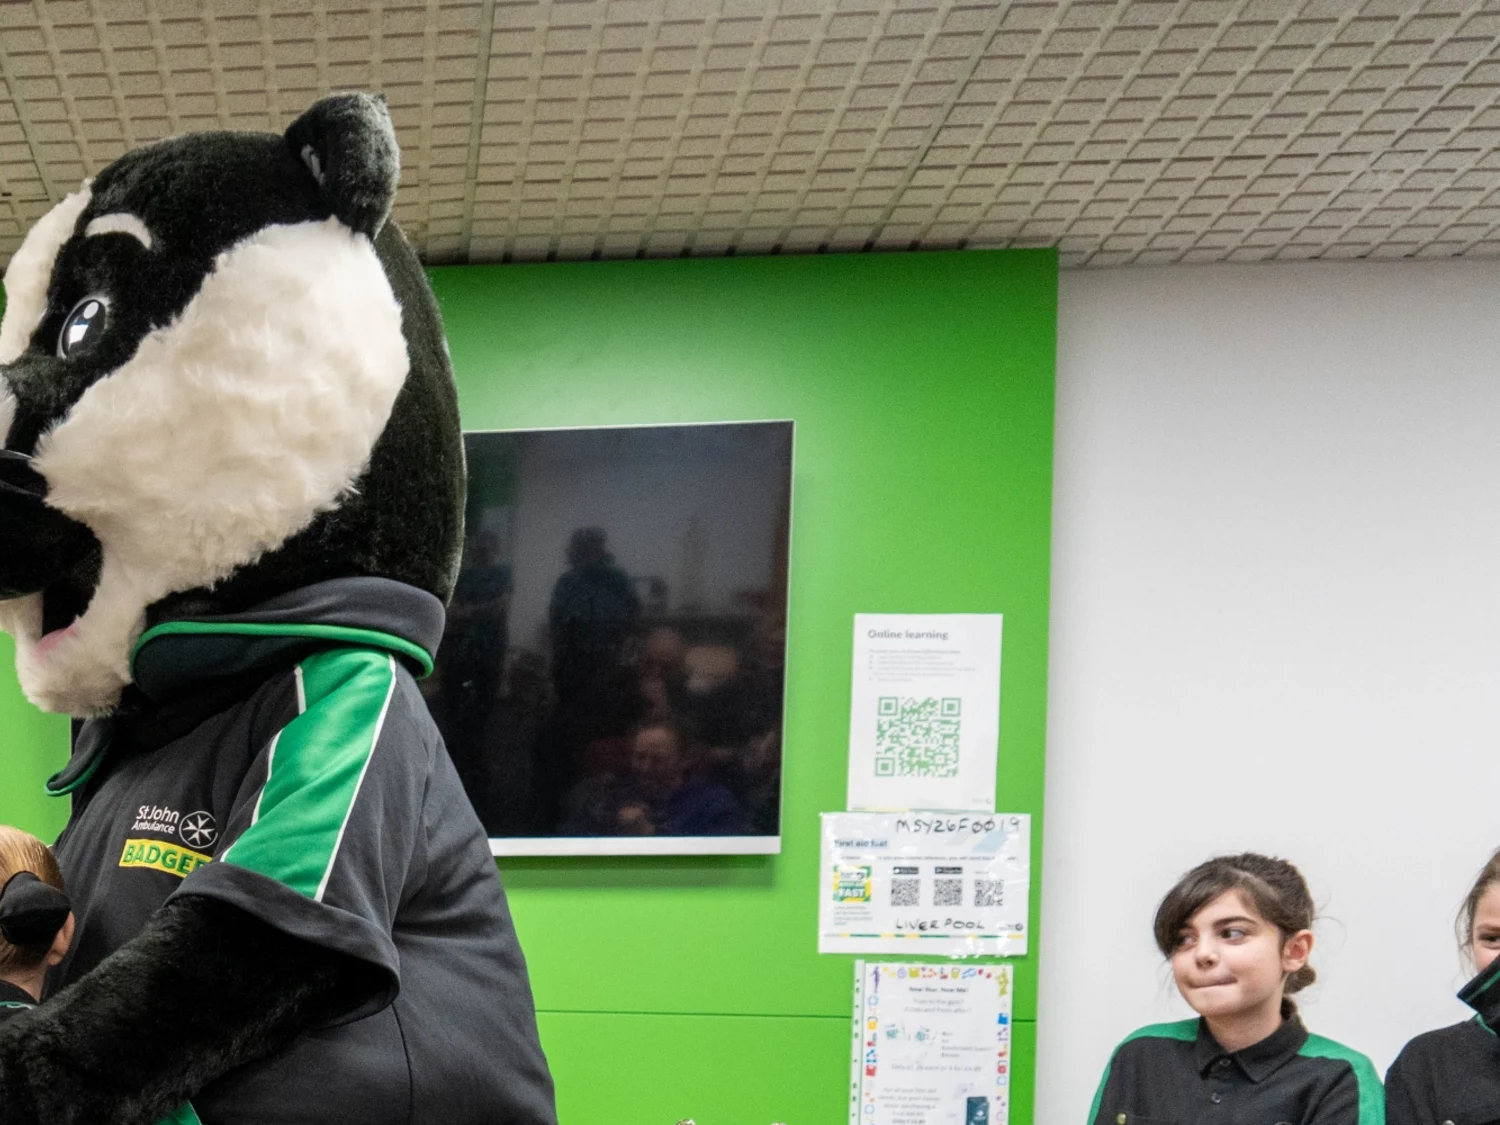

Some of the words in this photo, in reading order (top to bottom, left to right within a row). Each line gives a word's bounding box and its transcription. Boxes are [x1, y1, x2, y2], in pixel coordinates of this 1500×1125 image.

[867, 628, 903, 640] Online
[905, 629, 949, 642] learning
[136, 805, 150, 820] St
[148, 806, 180, 824] John
[131, 820, 176, 835] Ambulance
[122, 844, 208, 874] BADGE
